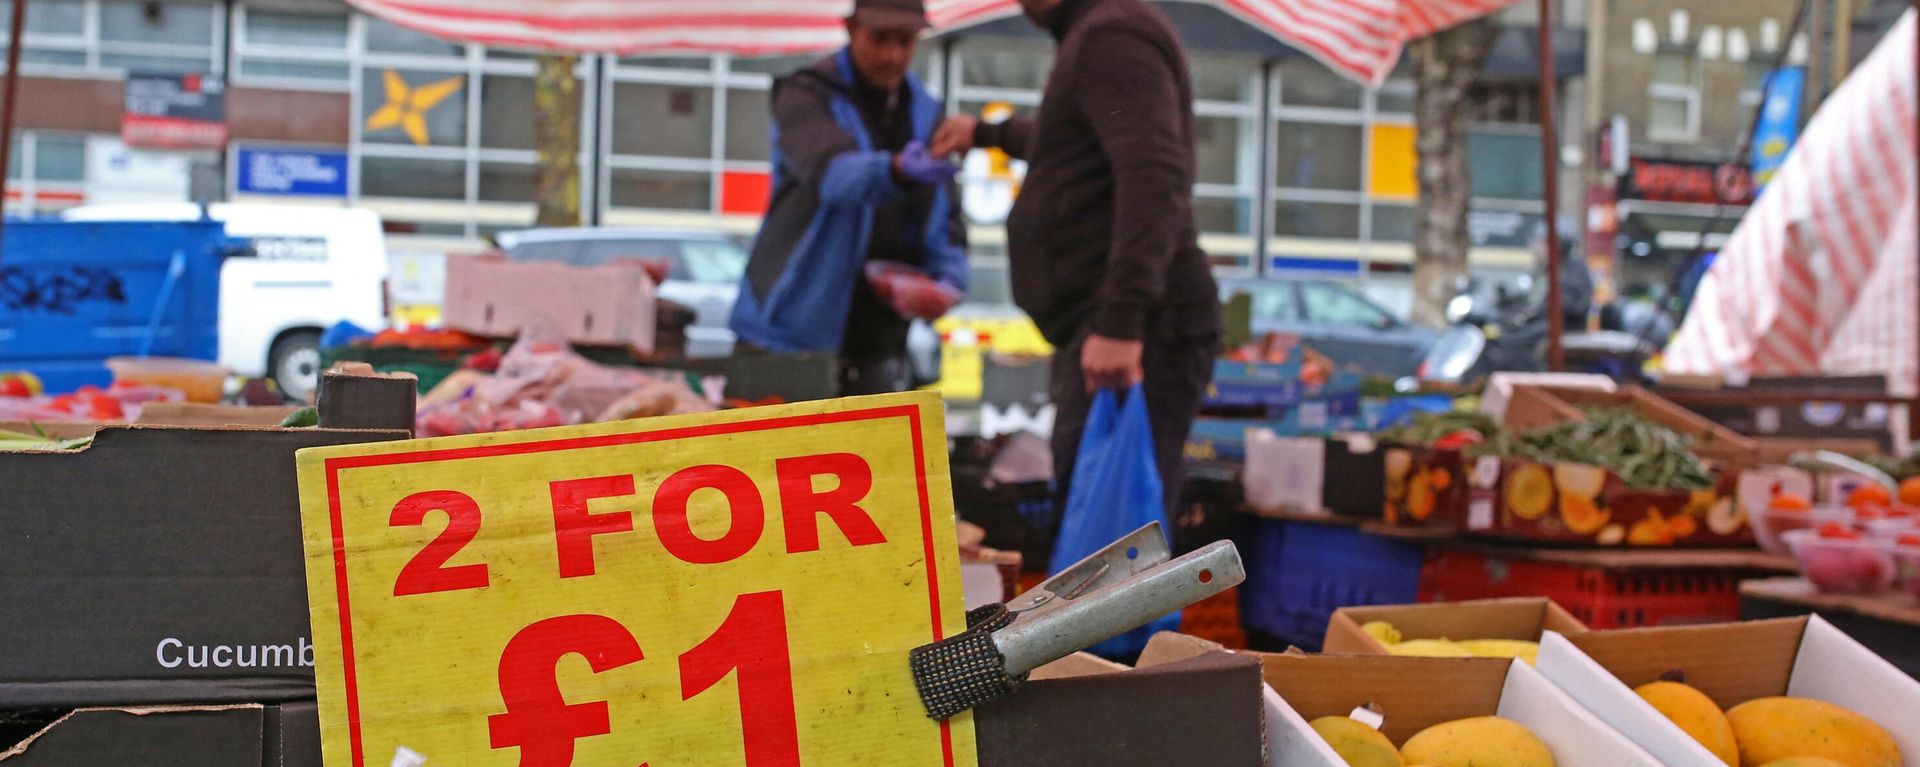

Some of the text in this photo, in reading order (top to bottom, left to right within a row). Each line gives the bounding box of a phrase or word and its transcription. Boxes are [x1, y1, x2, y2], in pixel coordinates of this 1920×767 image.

[388, 452, 888, 597] 2 FOR
[156, 637, 315, 668] Cucumb
[487, 589, 802, 767] £1
